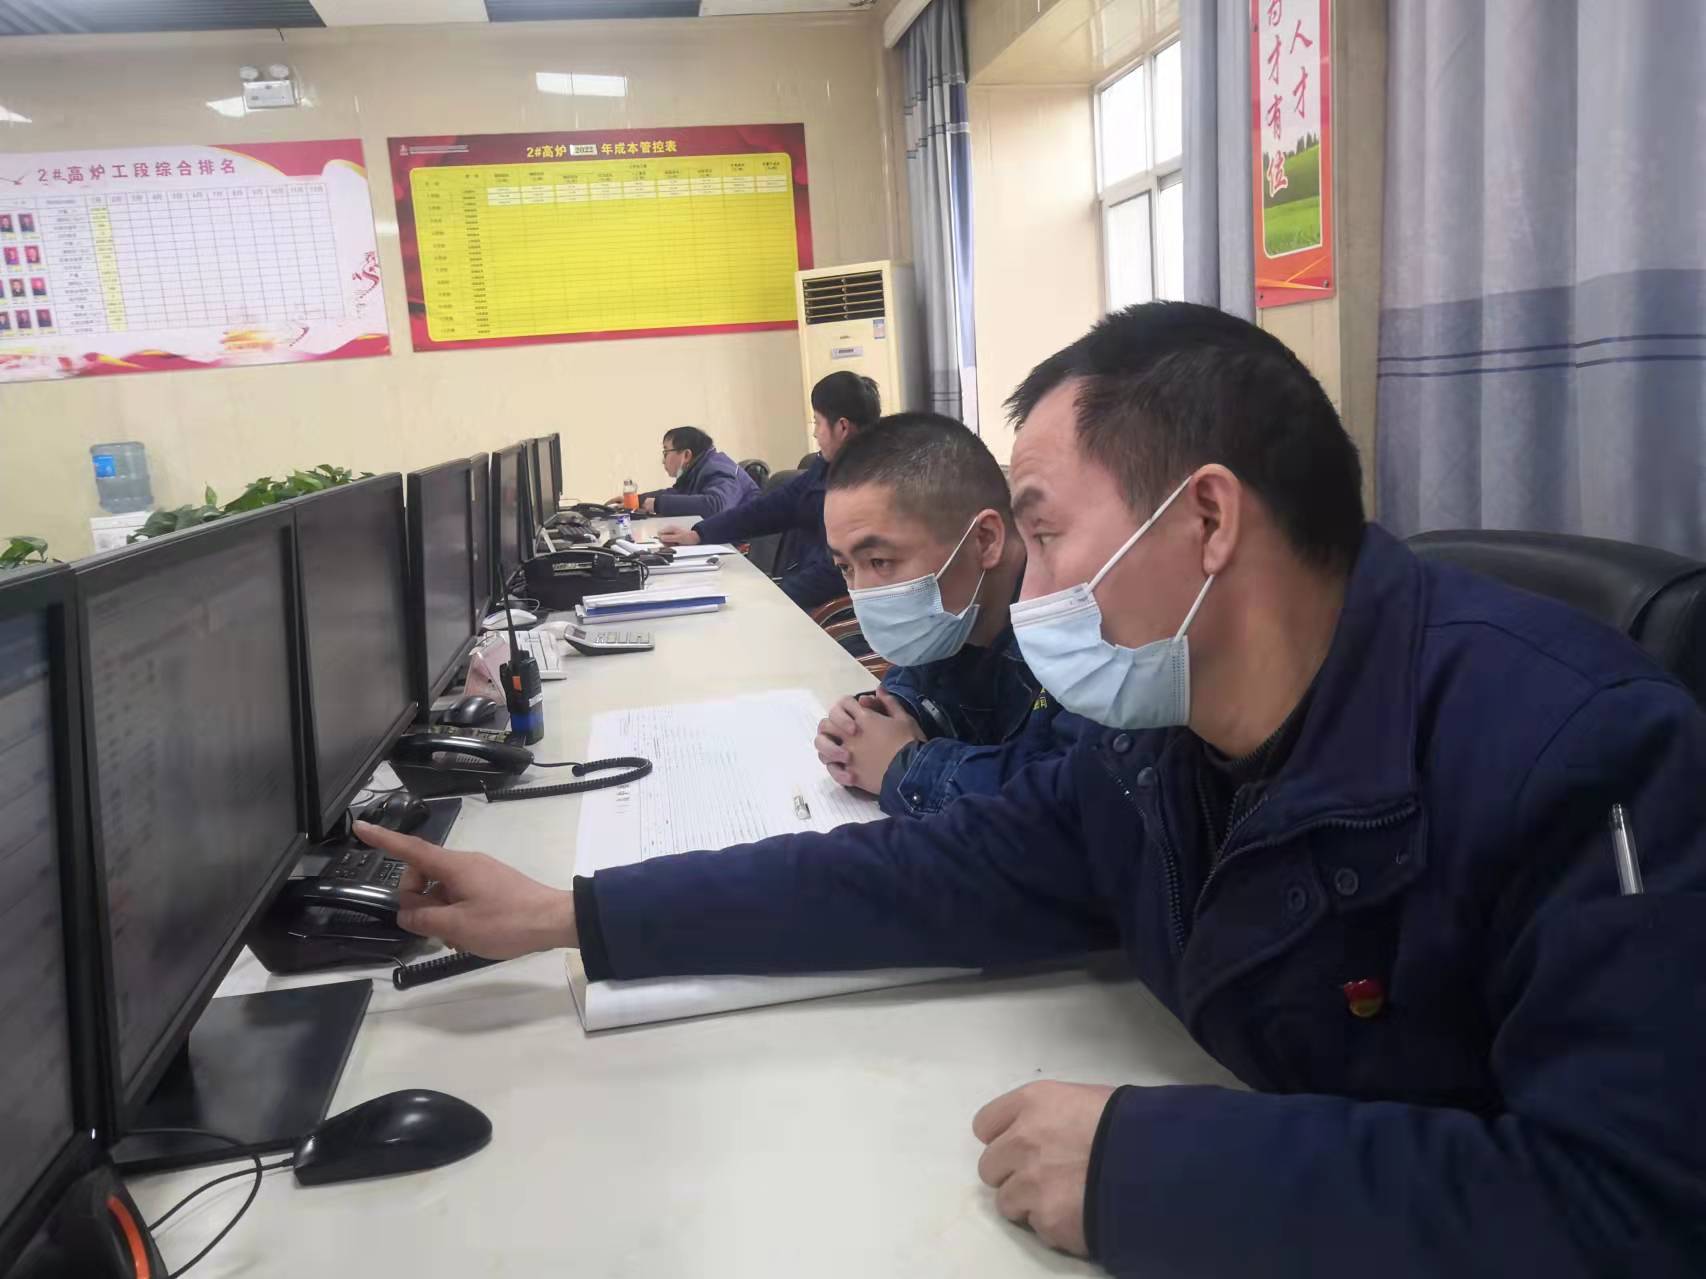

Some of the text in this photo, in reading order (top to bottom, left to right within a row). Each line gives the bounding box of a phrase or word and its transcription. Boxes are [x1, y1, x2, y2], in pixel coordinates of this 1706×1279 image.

[1288, 19, 1313, 118] 人才
[37, 158, 236, 184] 2#高炉工段综合排名
